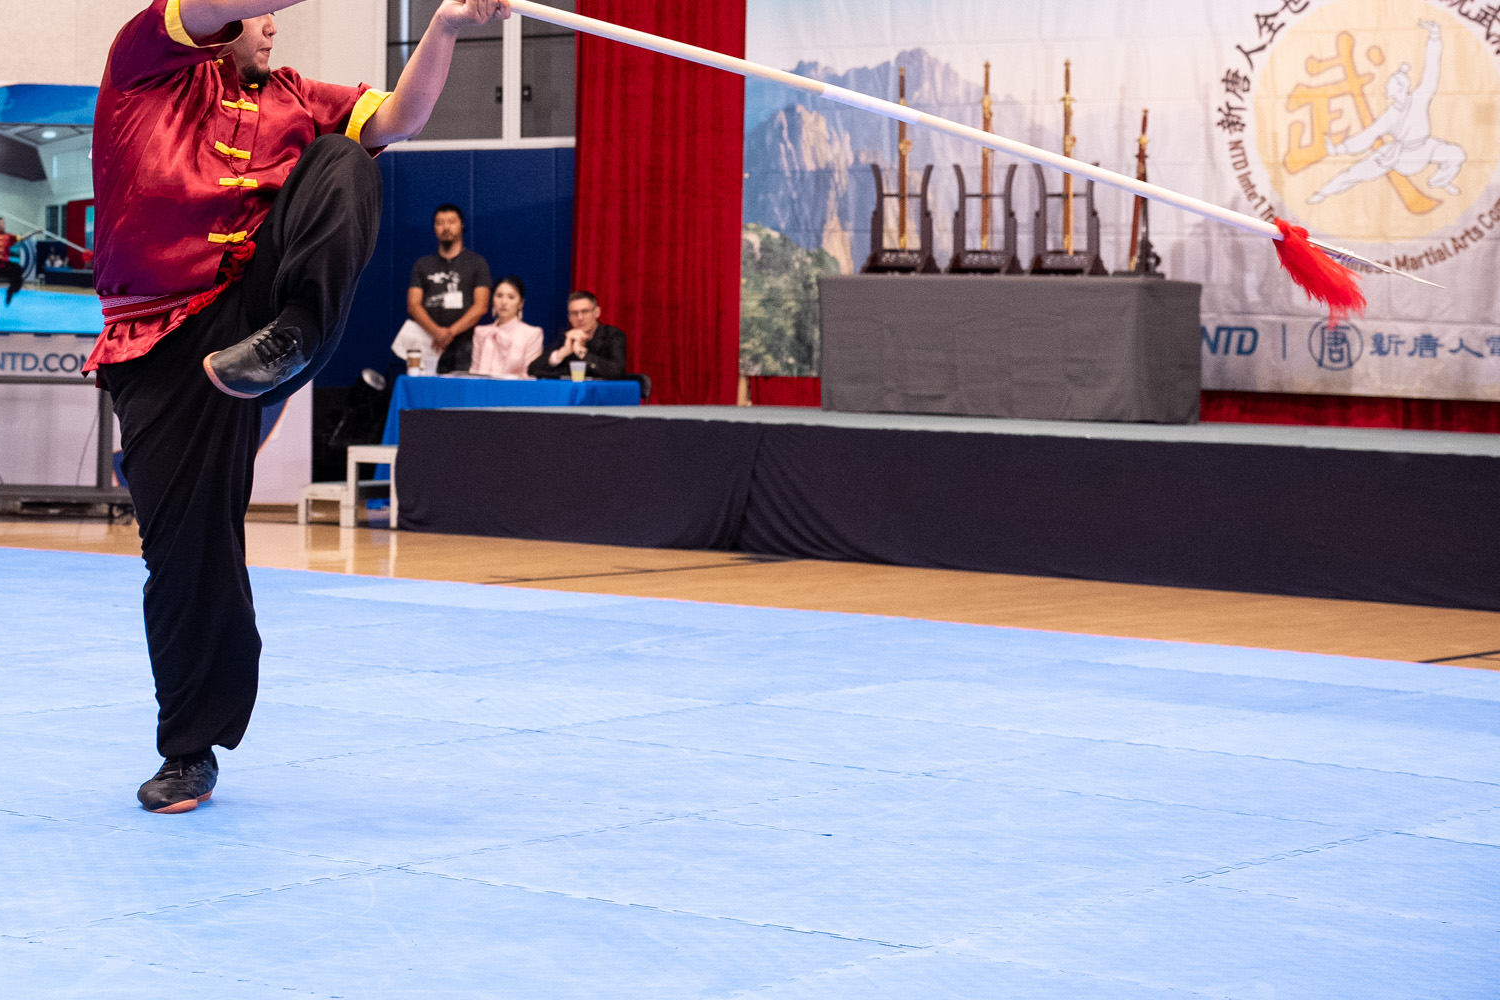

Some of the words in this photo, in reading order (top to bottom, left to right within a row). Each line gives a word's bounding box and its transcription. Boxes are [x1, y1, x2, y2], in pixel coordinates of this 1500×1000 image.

[1228, 139, 1249, 171] NTD
[1394, 242, 1454, 272] Martial
[1450, 225, 1485, 255] Arts
[1201, 324, 1259, 357] NTD
